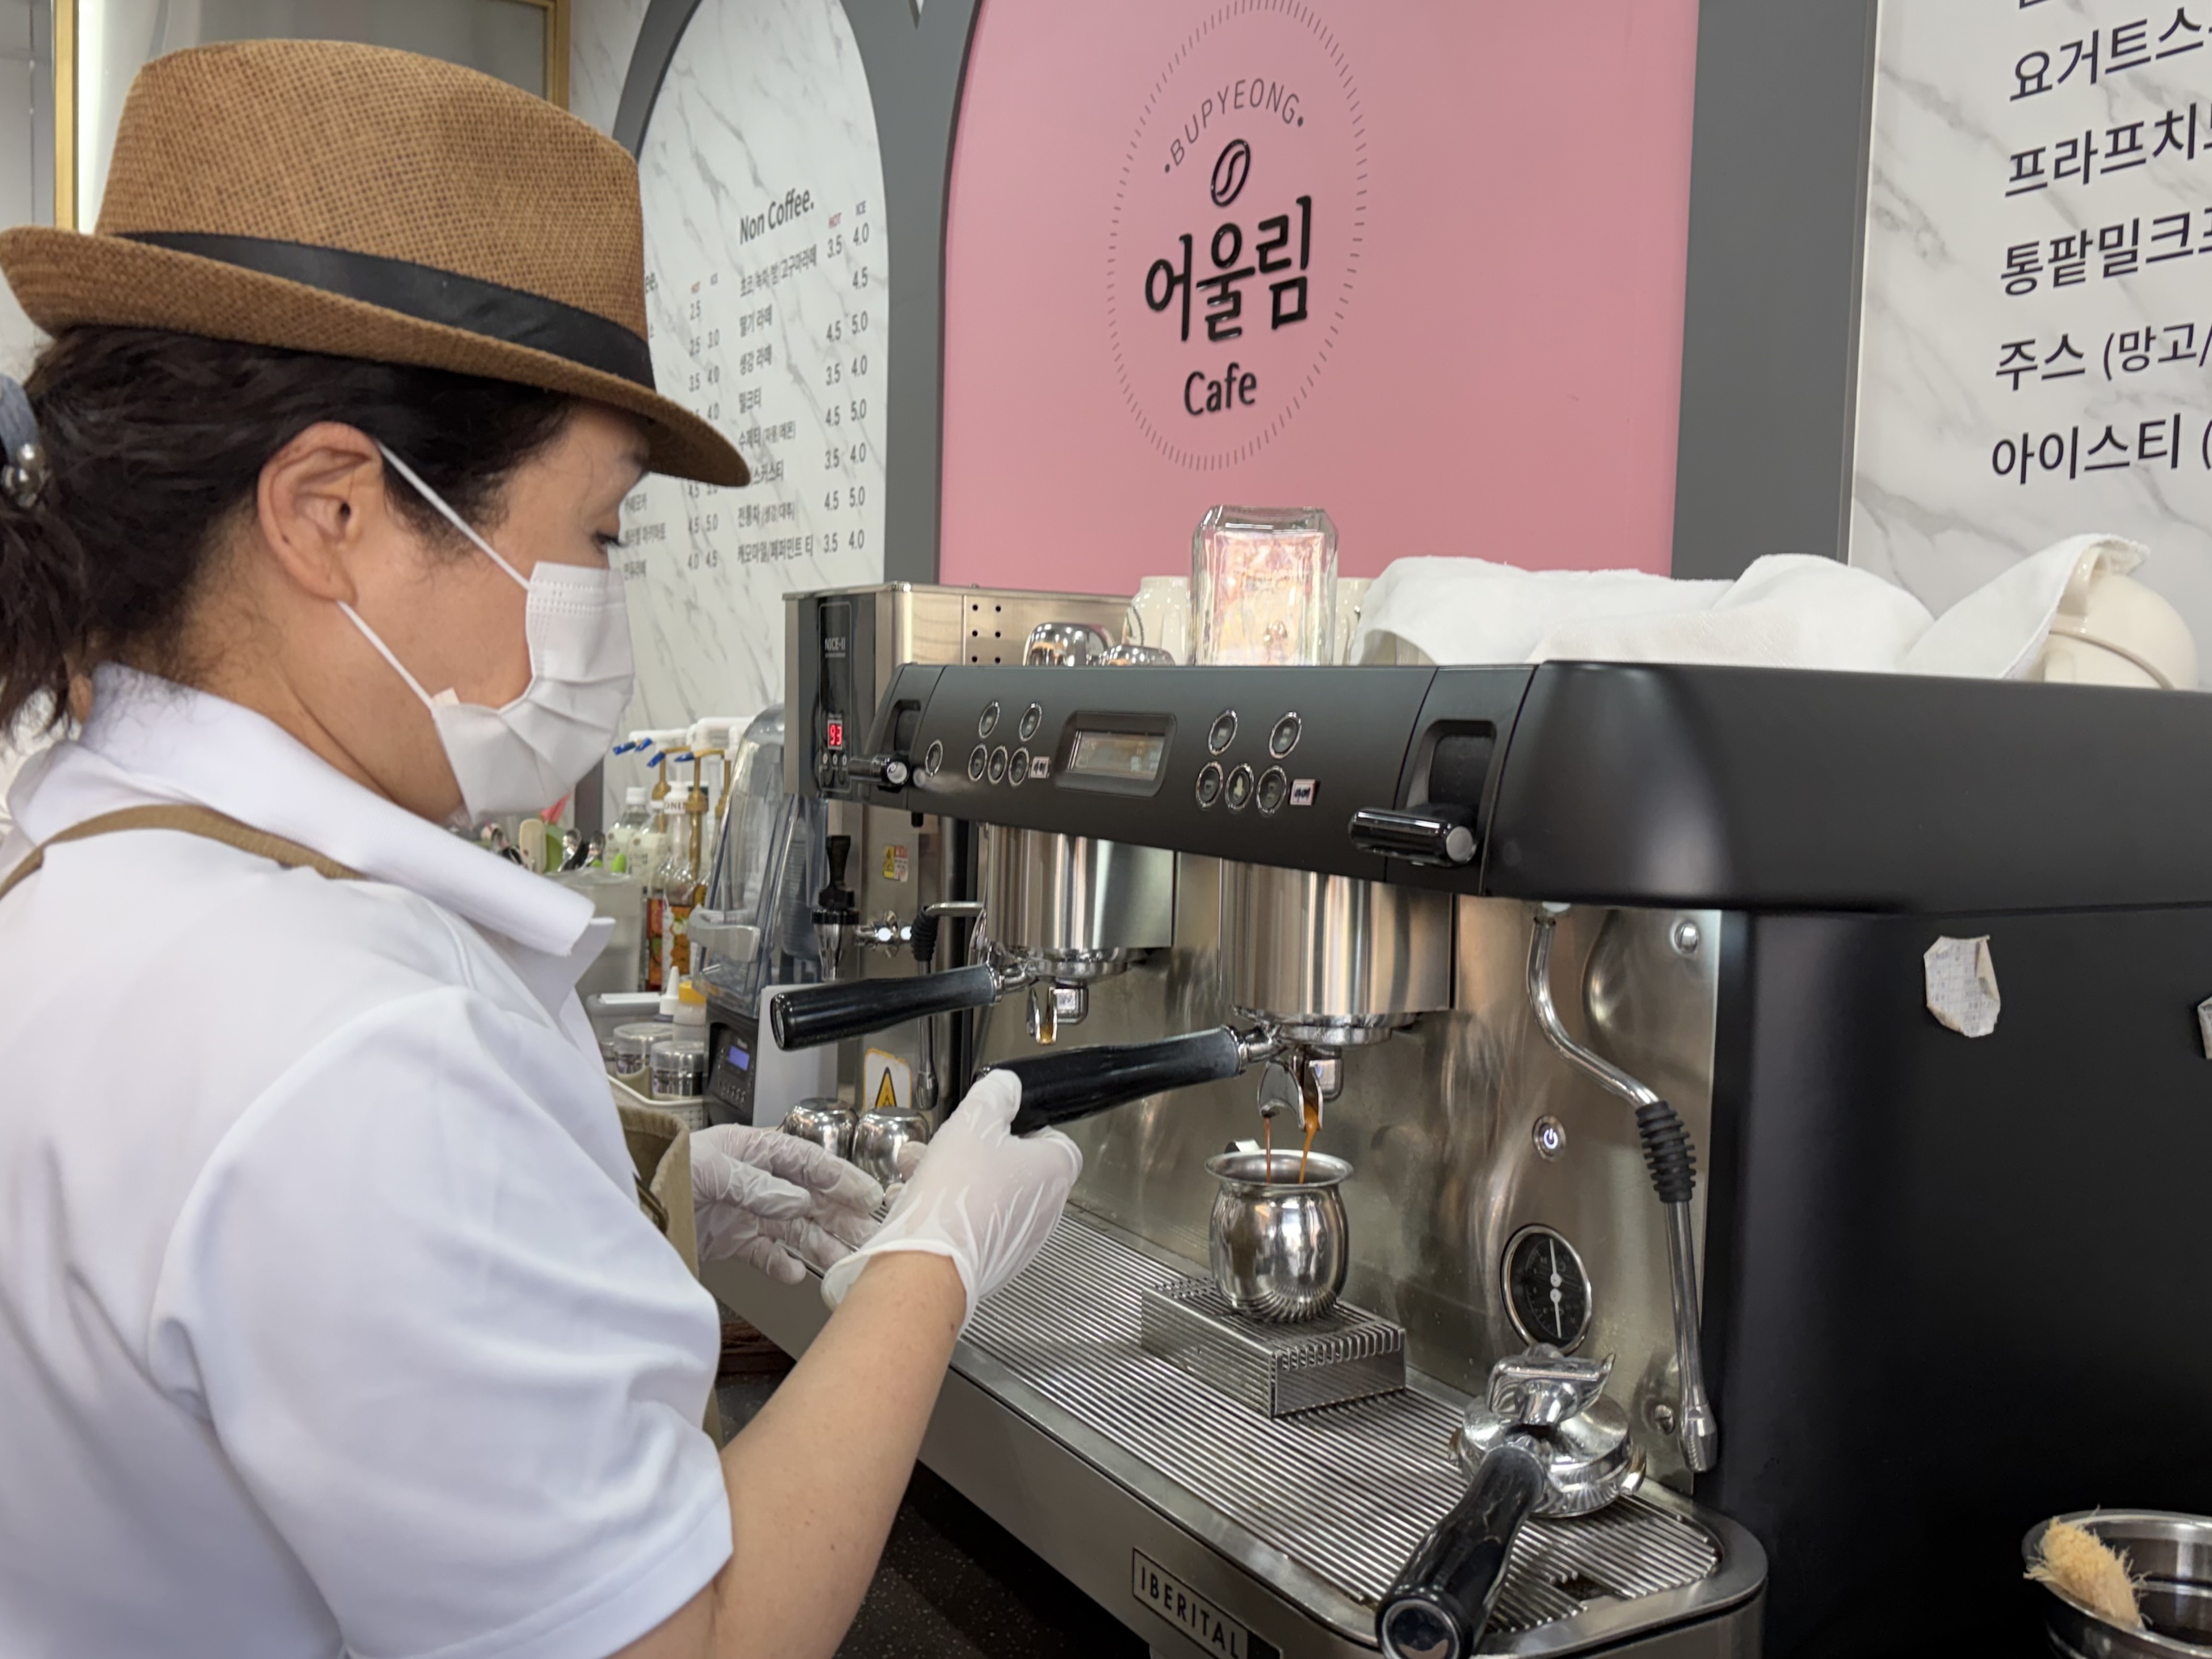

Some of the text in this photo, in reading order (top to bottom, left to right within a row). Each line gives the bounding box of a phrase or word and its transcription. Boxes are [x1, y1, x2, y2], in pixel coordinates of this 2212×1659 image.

[2010, 7, 2212, 102] 요거트스
[1170, 78, 1299, 166] BUPYEONG
[740, 188, 814, 245] Non Coffee.
[828, 234, 842, 258] 3.5
[853, 222, 869, 246] 4.0
[1145, 195, 1312, 342] 어울림
[740, 310, 755, 337] 딸기
[852, 266, 868, 290] 4.5
[826, 320, 841, 343] 4.5
[852, 310, 868, 335] 5.0
[739, 354, 867, 414] 밀크티 3.5 4.0
[1184, 362, 1257, 415] Cafe
[1996, 333, 2085, 391] 주스
[825, 405, 840, 427] 4.5
[851, 398, 867, 421] 5.0
[825, 448, 840, 470] 3.5
[850, 442, 866, 464] 4.0
[1992, 413, 2181, 485] 아이스티
[706, 513, 718, 532] 5.0
[824, 490, 839, 511] 4.5
[850, 486, 865, 508] 5.0
[805, 534, 813, 558] 티
[824, 532, 838, 553] 3.5
[849, 529, 864, 549] 4.0
[829, 724, 843, 746] 93
[1141, 1566, 1239, 1659] IBERITAL
